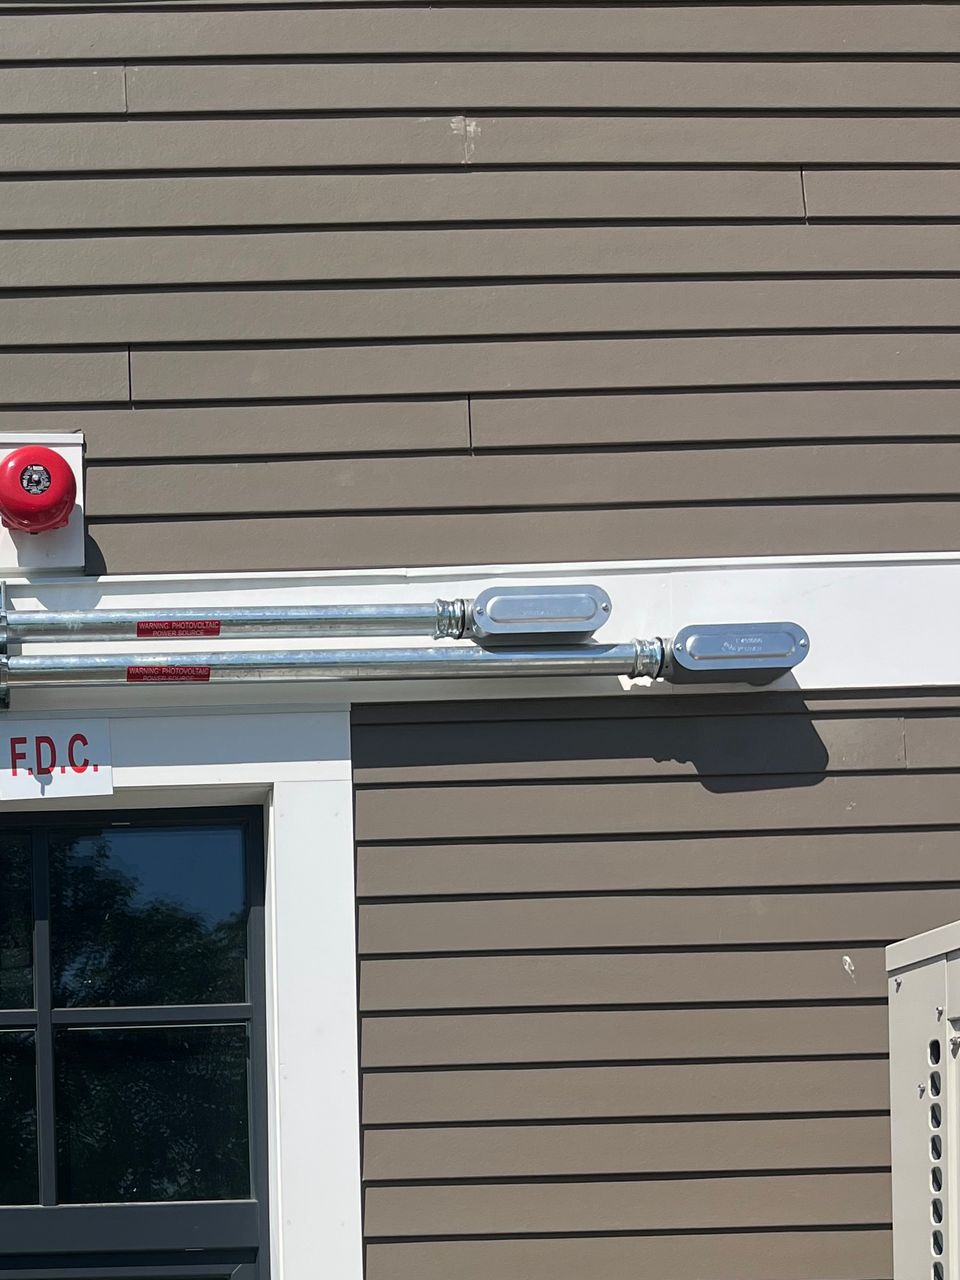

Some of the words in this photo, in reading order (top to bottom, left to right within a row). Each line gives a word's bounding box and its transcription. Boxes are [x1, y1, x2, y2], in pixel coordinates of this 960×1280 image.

[140, 622, 170, 630] WARNING:
[172, 621, 219, 629] PHOTOVOLTAIC
[162, 667, 209, 675] PHOTOVOLTAIC
[10, 733, 99, 776] F.D.C.
